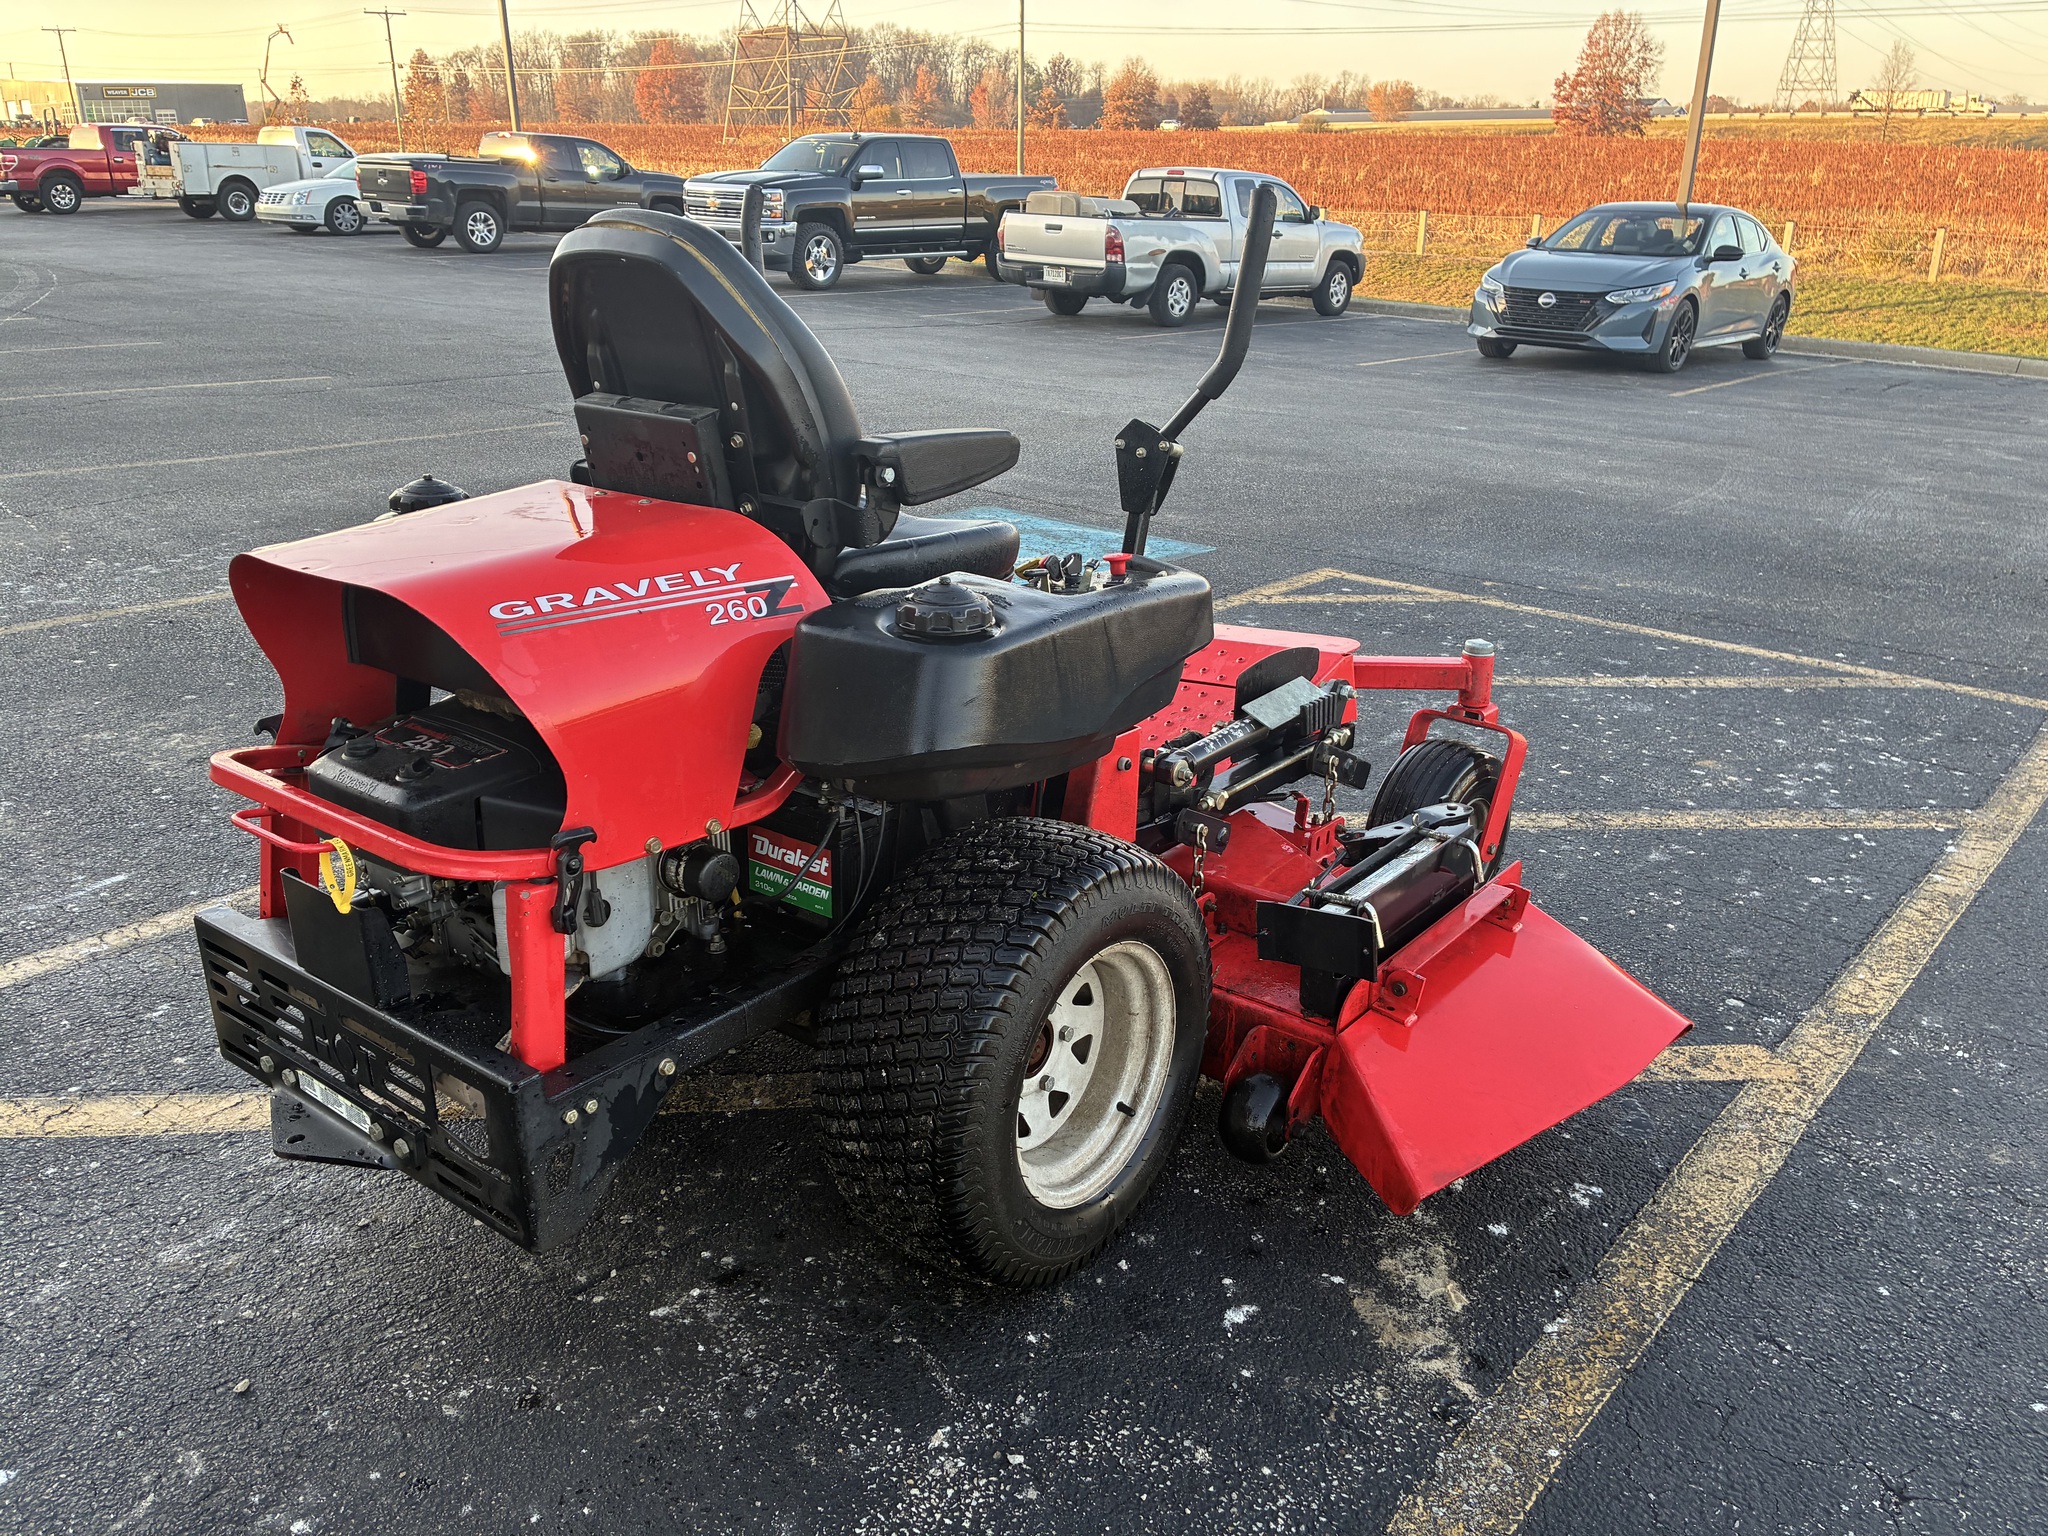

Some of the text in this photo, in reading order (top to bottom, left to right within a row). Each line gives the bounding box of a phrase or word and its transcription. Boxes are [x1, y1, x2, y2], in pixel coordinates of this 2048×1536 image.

[131, 88, 155, 96] JCB
[489, 562, 743, 620] GRAVELY
[333, 767, 379, 795] Kawasaki
[752, 834, 829, 877] Duralast
[755, 866, 783, 884] LAWN
[789, 879, 830, 900] ARDEN
[1102, 902, 1158, 929] MULTI
[309, 1017, 377, 1088] HOT
